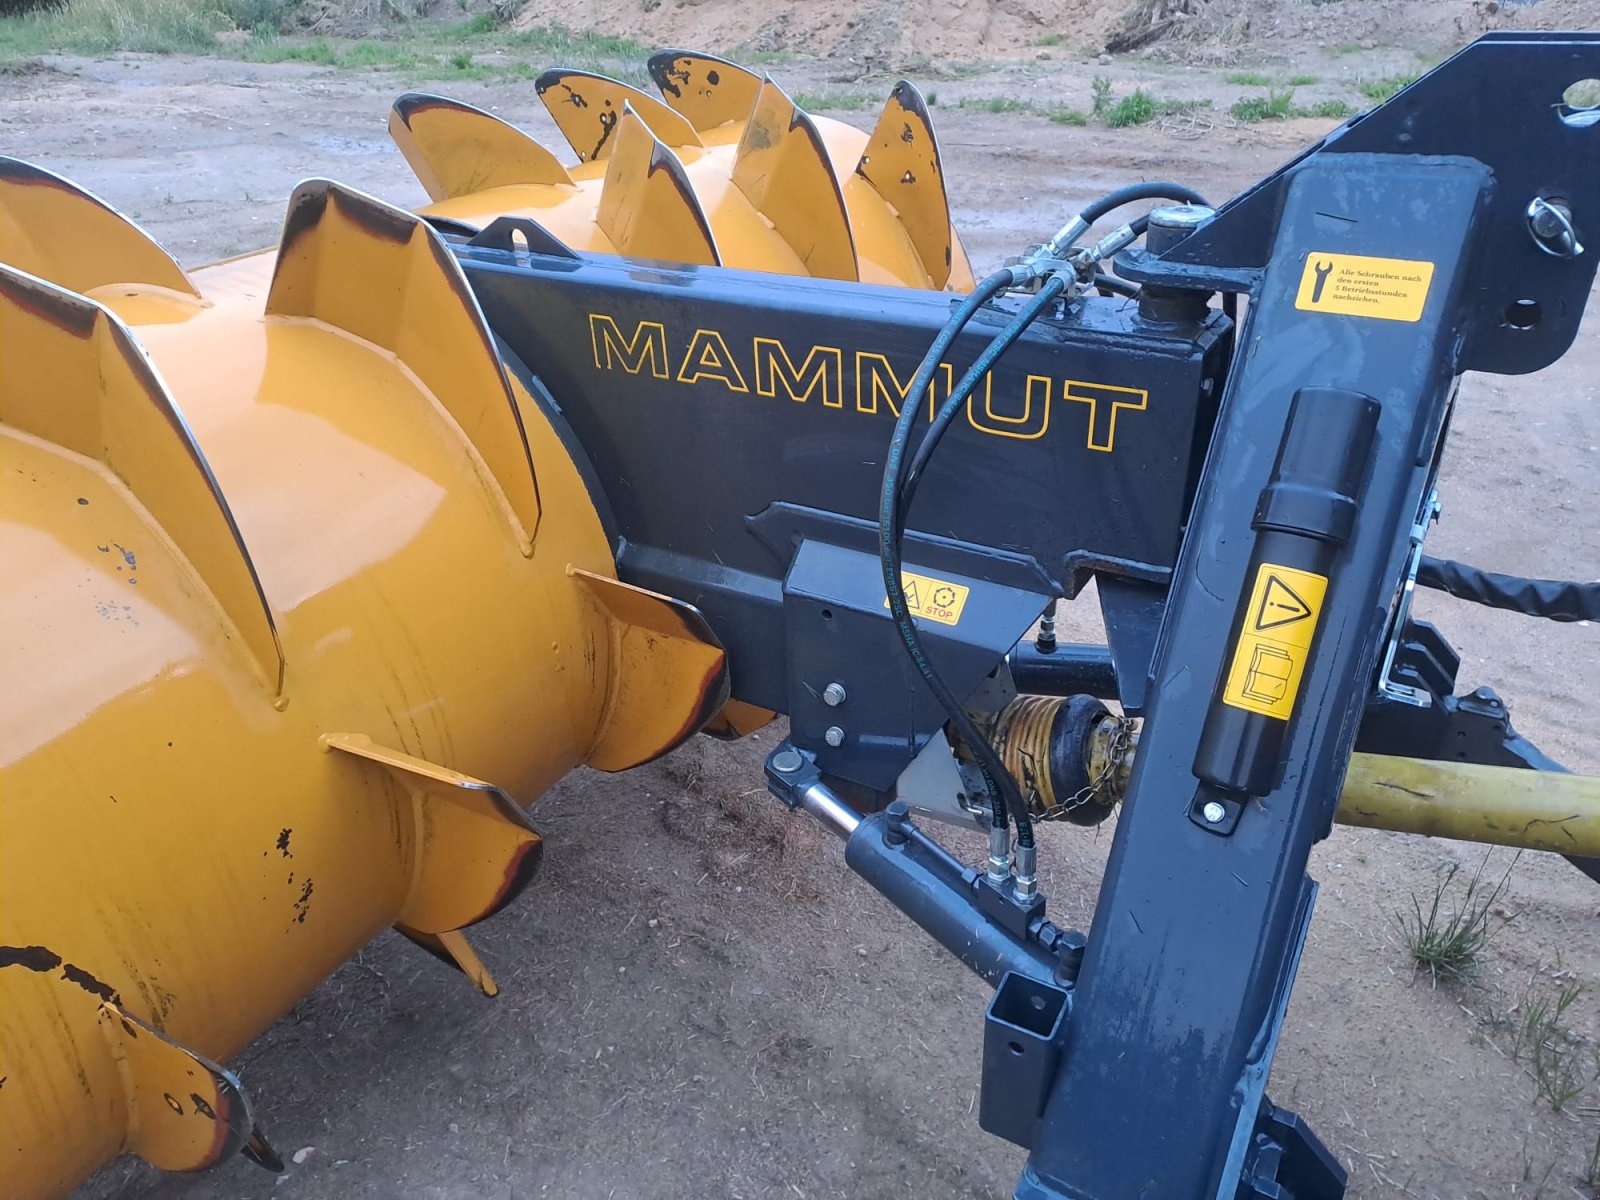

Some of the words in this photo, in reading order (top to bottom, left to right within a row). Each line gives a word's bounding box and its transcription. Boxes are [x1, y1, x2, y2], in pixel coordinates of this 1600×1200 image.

[1337, 276, 1352, 284] den
[1353, 279, 1379, 287] ersten
[1357, 270, 1400, 280] Schrauben
[1401, 274, 1422, 282] nach
[1342, 286, 1408, 298] Betriebsstunden
[588, 313, 1149, 452] MAMMUT
[926, 606, 953, 619] STOP
